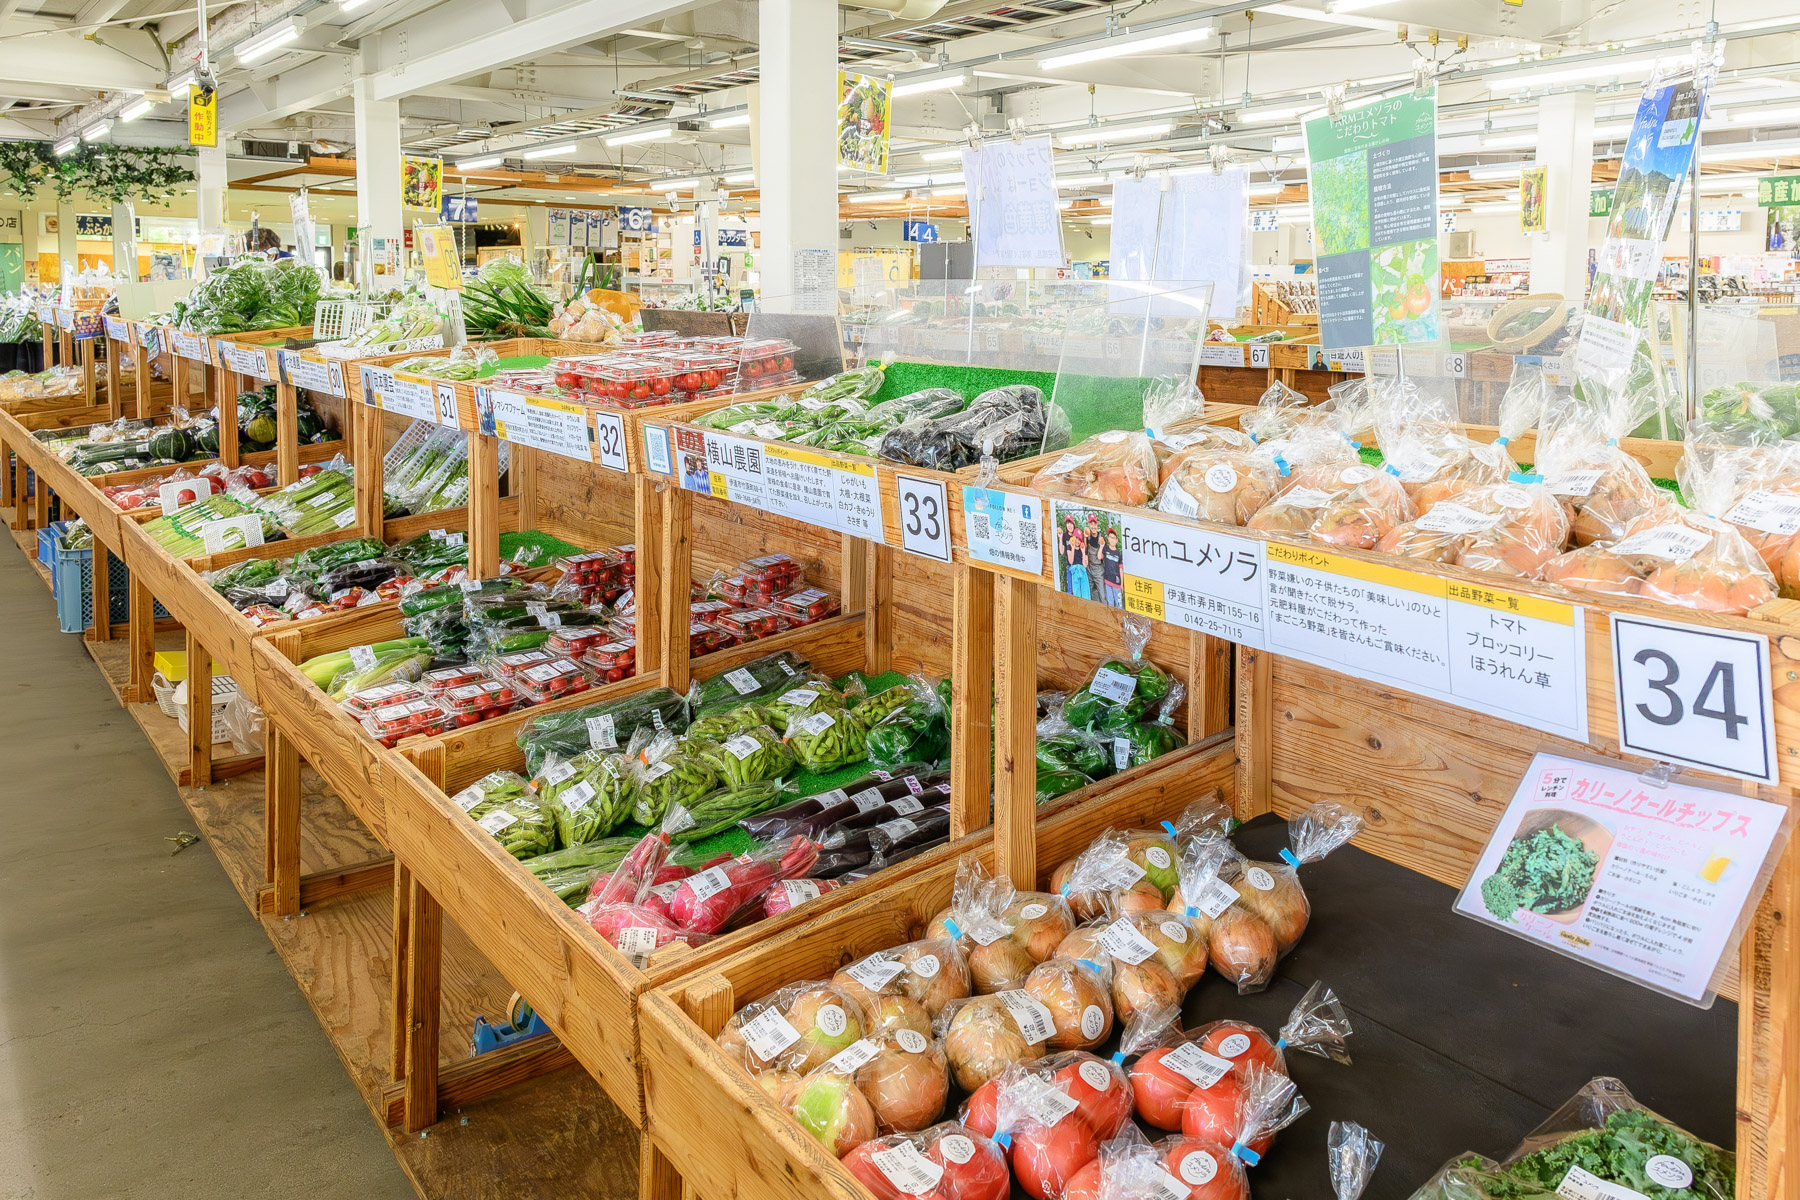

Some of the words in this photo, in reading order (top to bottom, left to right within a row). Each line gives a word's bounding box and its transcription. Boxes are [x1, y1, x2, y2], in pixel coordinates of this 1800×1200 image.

[194, 112, 204, 142] 作動中
[1336, 114, 1397, 139] こだわりトマト
[1372, 149, 1391, 159] 土づくり
[1759, 179, 1800, 203] 農産加
[449, 198, 465, 221] 7
[628, 208, 643, 230] 6
[910, 227, 918, 240] 4
[924, 228, 933, 242] 4
[4, 246, 22, 274] パン
[1107, 342, 1118, 354] 66
[1252, 349, 1266, 362] 67
[1445, 357, 1463, 372] 68
[330, 366, 341, 388] 30
[440, 393, 454, 419] 31
[600, 424, 621, 457] 32
[707, 438, 761, 475] 横山農園
[840, 475, 867, 489] じゃがいも
[840, 488, 871, 503] 大根・大根菜
[838, 501, 875, 517] 白カブ・きゅうり
[904, 491, 940, 541] 33
[1122, 527, 1258, 582] farmユメソラ
[1268, 545, 1330, 567] こだわりポイント
[1668, 546, 1691, 554] ¥292
[1134, 579, 1153, 595] 住所
[1268, 568, 1441, 618] 野菜嫌いの子供たちの「美味しい」のひと
[1448, 585, 1519, 610] 出品野菜一覧
[1128, 597, 1163, 617] 電話番号
[1168, 588, 1260, 623] 伊達市弄月町155-16
[1269, 583, 1360, 614] 言が聞きたくて脱サラ。
[1184, 613, 1243, 639] 0142-25-7115
[1270, 598, 1388, 636] 元肥料屋がこだわって作った
[1489, 614, 1527, 635] トマト
[1270, 612, 1446, 667] 「まごころ野菜」を皆さんもご賞味ください。
[1466, 631, 1554, 662] ブロッコリー
[1471, 654, 1552, 689] ほうれん草
[1634, 648, 1748, 741] 34
[1540, 784, 1565, 792] レンチン
[1542, 772, 1567, 786] 5分で
[1570, 778, 1752, 838] カリーノケールチップス
[698, 887, 708, 898] ¥135
[1023, 1025, 1034, 1042] ¥270
[840, 1058, 854, 1069] ¥270
[1196, 1077, 1210, 1086] ¥324
[1040, 1112, 1054, 1125] ¥324
